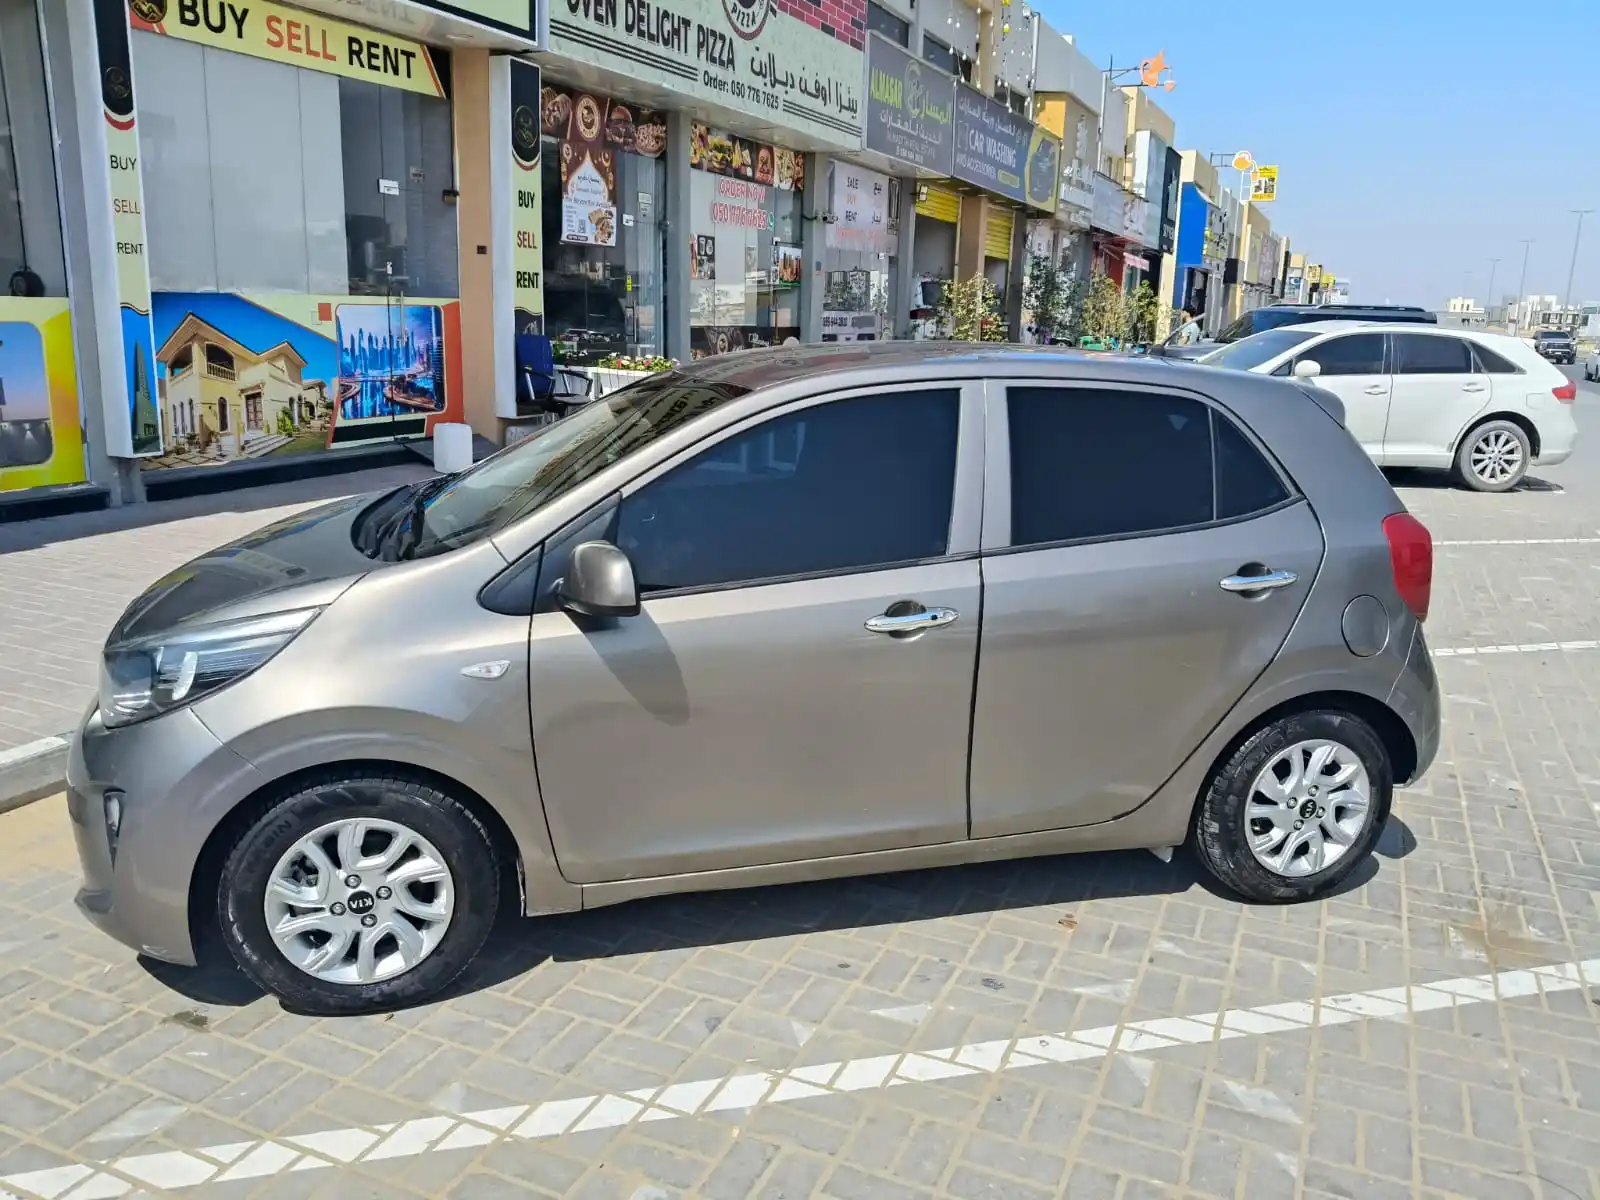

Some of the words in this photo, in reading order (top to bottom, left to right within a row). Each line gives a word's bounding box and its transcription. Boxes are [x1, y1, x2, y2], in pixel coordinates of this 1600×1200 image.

[731, 2, 756, 28] PIZZA
[179, 0, 249, 39] BUY
[265, 14, 337, 61] SELL
[347, 36, 416, 78] RENT
[696, 23, 735, 73] PIZZA
[703, 70, 729, 93] Order:
[731, 80, 745, 99] 050
[747, 86, 760, 104] 776
[762, 90, 779, 110] 7625
[969, 129, 984, 154] CAR
[986, 136, 1016, 168] WASHING
[110, 155, 137, 170] BUY
[718, 177, 746, 199] ORDER
[114, 198, 140, 214] SELL
[518, 190, 535, 208] BUY
[117, 242, 144, 255] RENT
[517, 231, 537, 249] SELL
[516, 271, 539, 289] RENT
[350, 897, 373, 908] KIA
